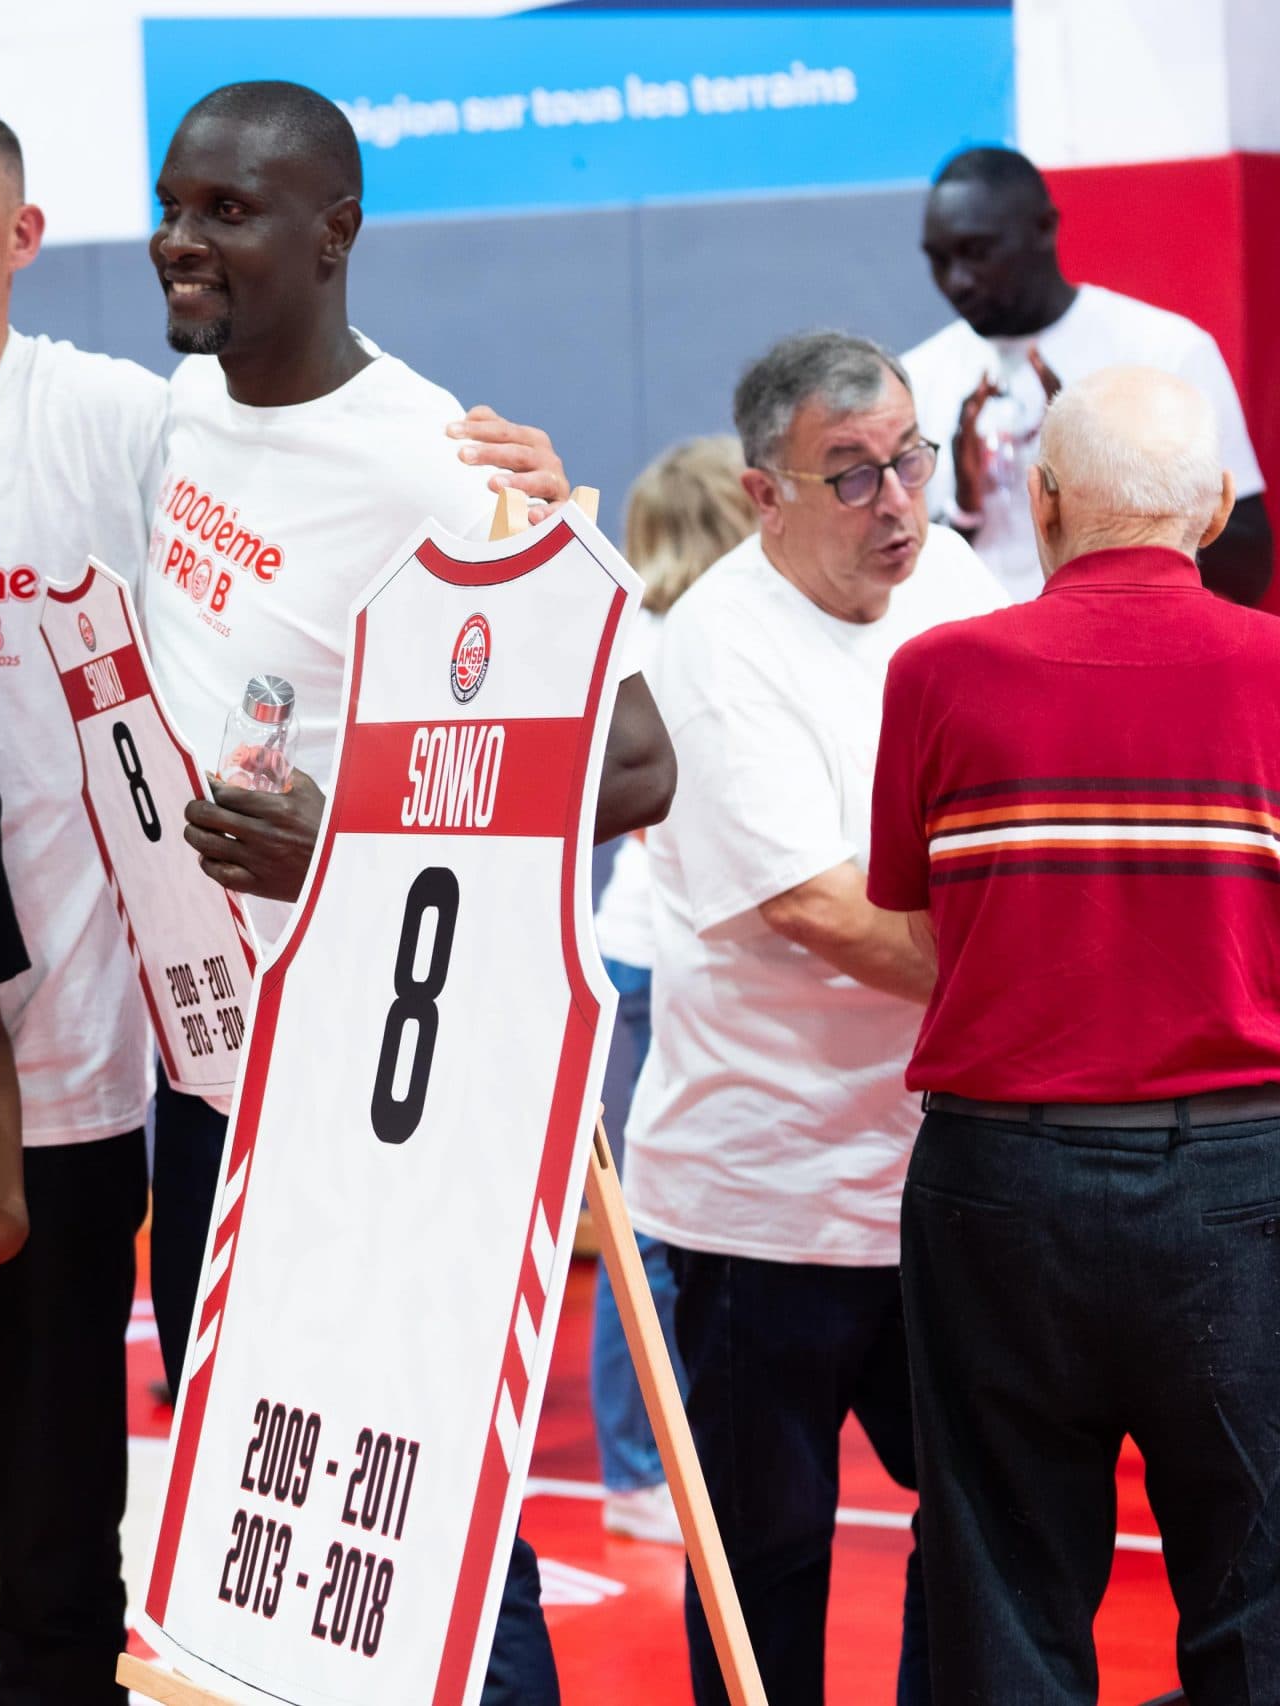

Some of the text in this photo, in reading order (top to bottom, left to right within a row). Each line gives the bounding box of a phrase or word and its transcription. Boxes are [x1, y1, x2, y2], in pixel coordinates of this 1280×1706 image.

[462, 95, 526, 133] sur
[531, 86, 623, 128] tous
[624, 73, 687, 119] les
[690, 60, 857, 115] terrains
[166, 479, 282, 581] 1000ème
[210, 571, 232, 613] B
[83, 655, 126, 711] SONKO
[458, 645, 484, 665] AMSB
[112, 721, 162, 842] 8
[401, 725, 505, 828] SONKO
[165, 962, 201, 1008] 2009
[203, 954, 236, 1002] 2011
[371, 866, 459, 1144] 8
[181, 1012, 214, 1058] 2013
[241, 1397, 321, 1508] 2009
[341, 1426, 420, 1541] 2011
[218, 1508, 292, 1619] 2013
[311, 1540, 394, 1658] 2018
